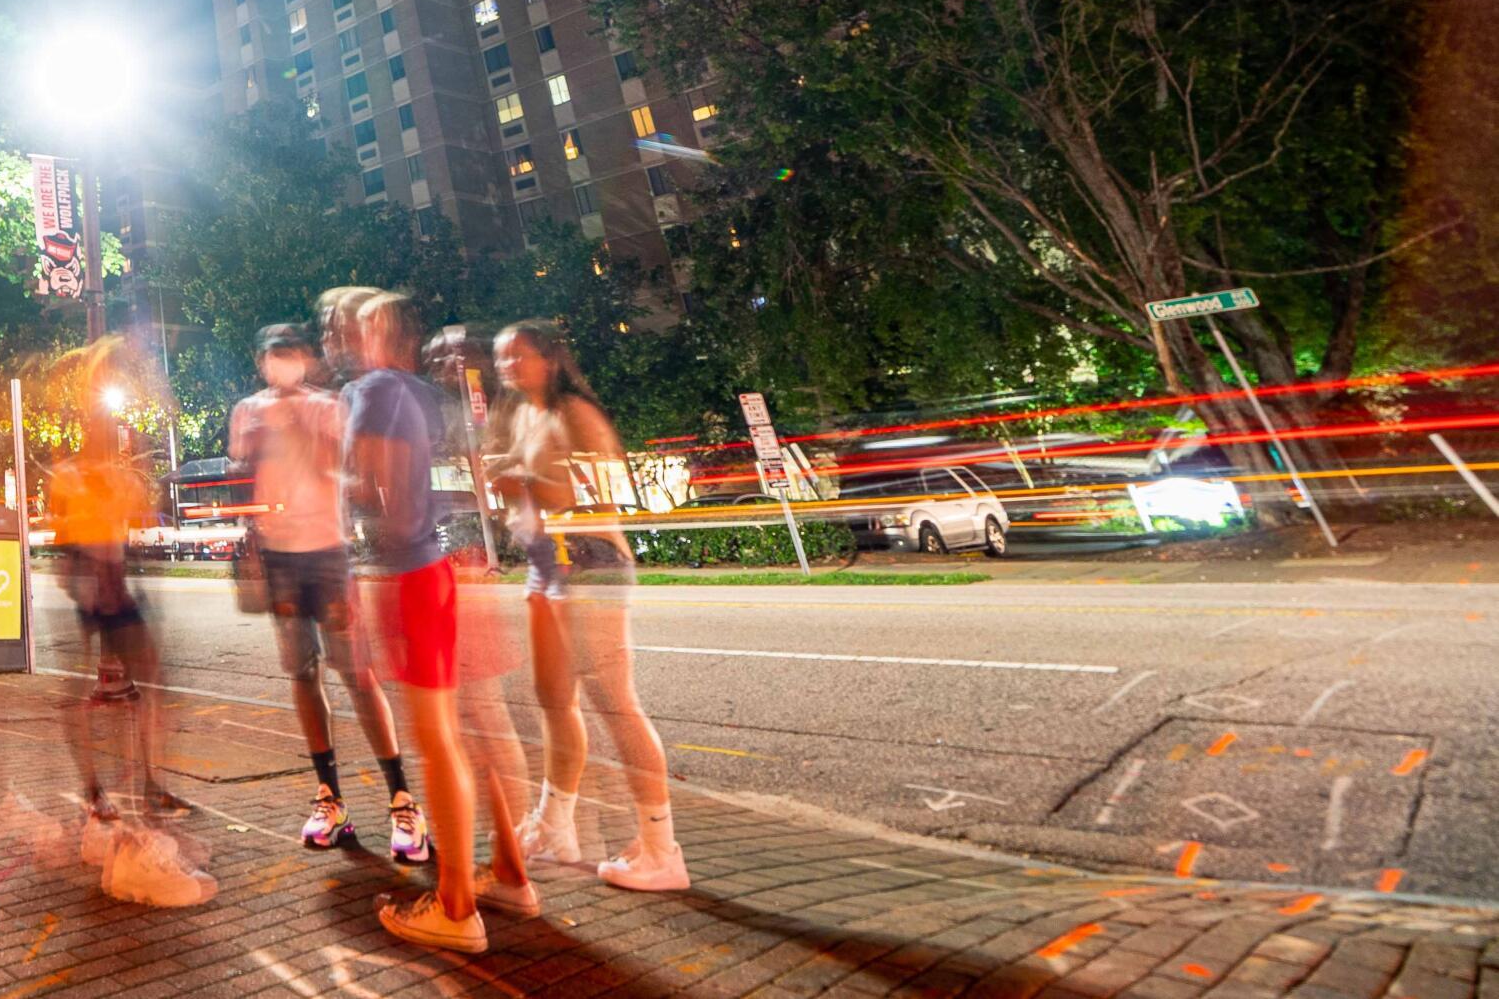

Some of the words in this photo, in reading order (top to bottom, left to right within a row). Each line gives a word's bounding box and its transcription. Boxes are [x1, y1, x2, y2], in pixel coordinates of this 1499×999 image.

[40, 165, 52, 185] THE
[41, 188, 54, 208] ARE
[57, 169, 72, 228] WOLFPACK
[43, 211, 55, 229] WE
[1153, 296, 1223, 318] Glenwood
